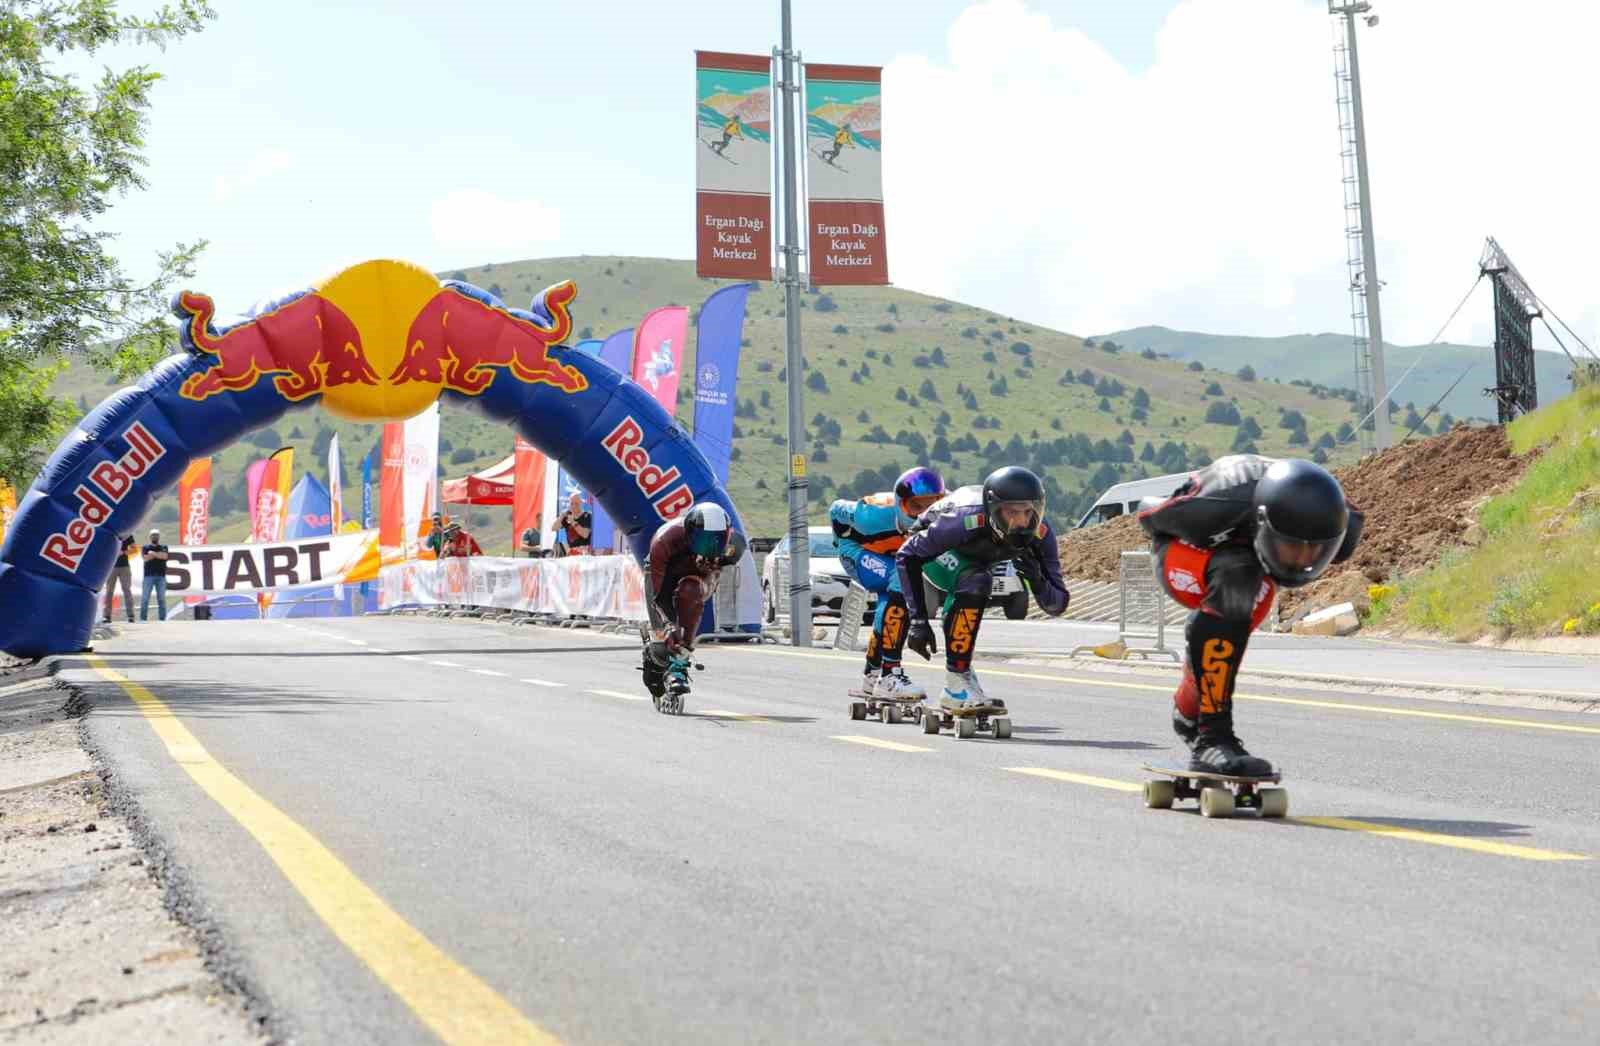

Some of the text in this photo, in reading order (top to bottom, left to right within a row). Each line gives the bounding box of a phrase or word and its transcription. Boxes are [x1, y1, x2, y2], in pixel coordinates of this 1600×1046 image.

[705, 214, 764, 231] Ergan Dağı
[817, 223, 879, 238] Ergan Dağı
[718, 231, 752, 246] Kayak
[831, 239, 866, 253] Kayak
[713, 247, 757, 260] Merkezi
[826, 254, 872, 266] Merkezi
[600, 415, 681, 499] Red
[40, 420, 167, 573] Red Bull
[165, 542, 330, 591] START
